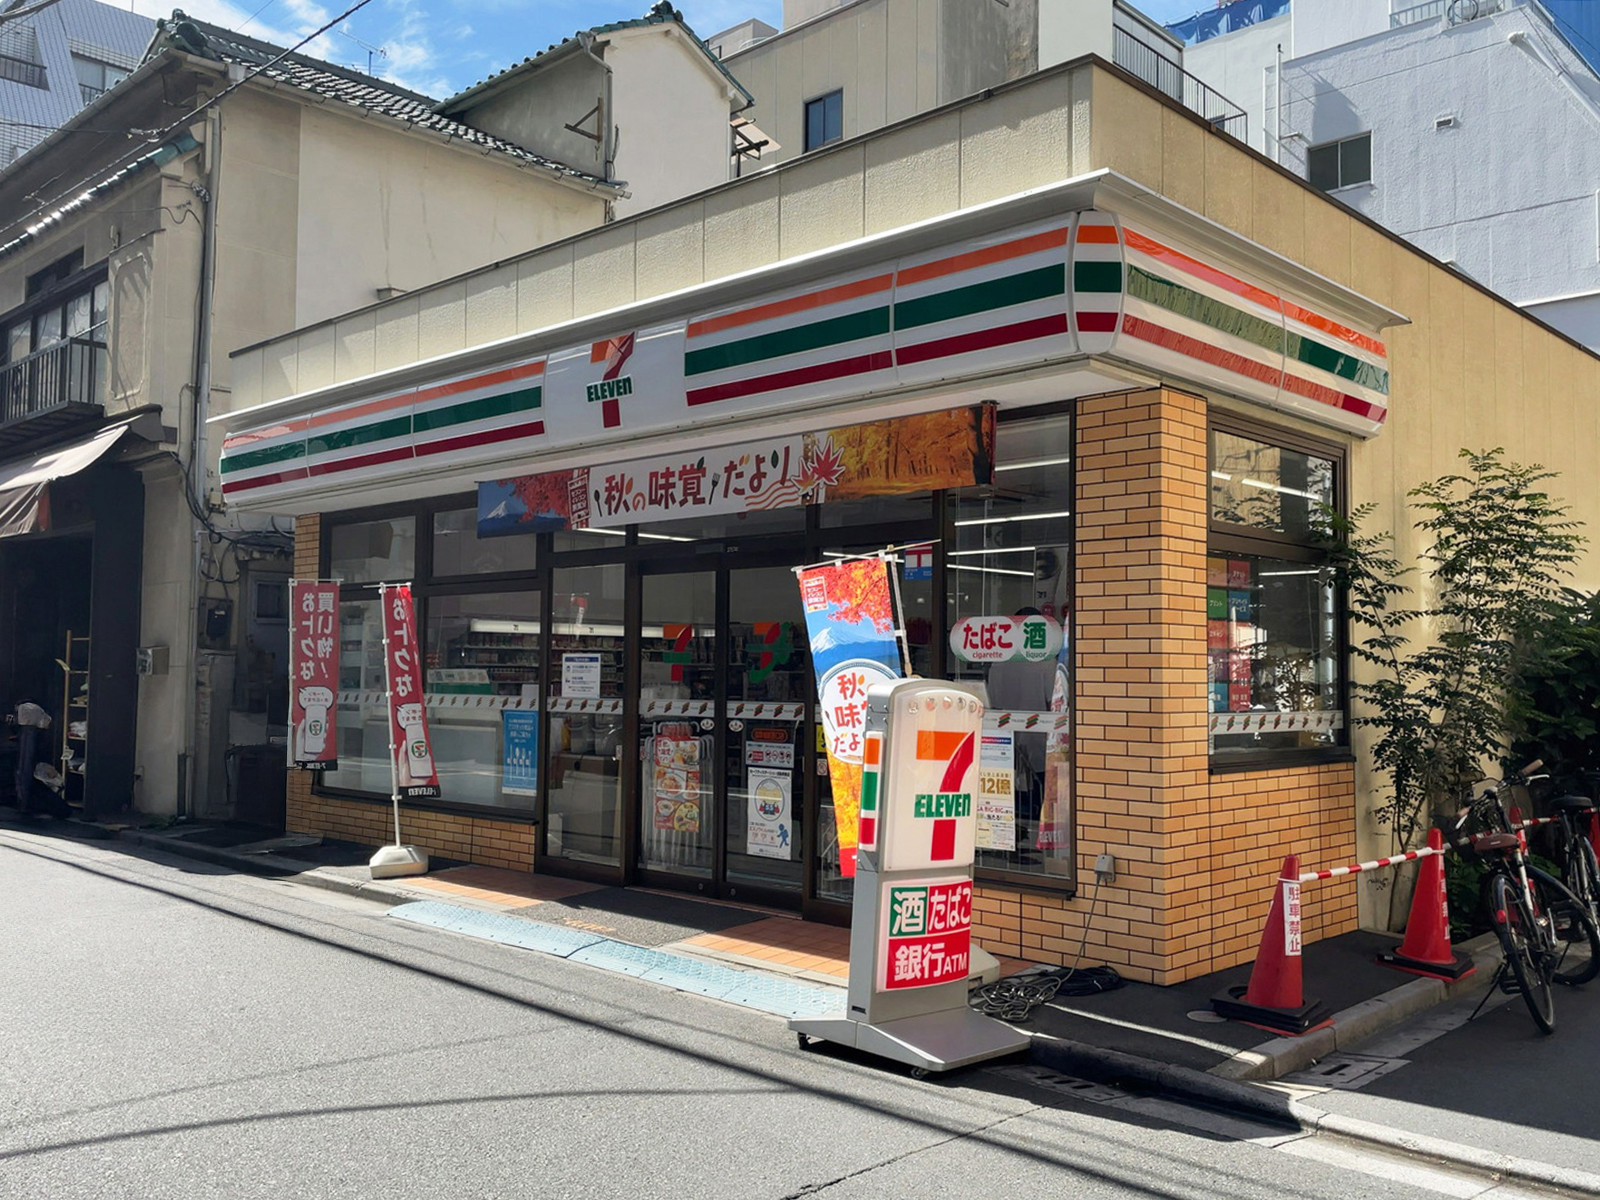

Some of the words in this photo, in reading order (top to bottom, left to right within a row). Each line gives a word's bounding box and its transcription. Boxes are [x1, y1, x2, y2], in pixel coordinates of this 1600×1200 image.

[963, 622, 1013, 650] たばこ
[1023, 622, 1047, 650] 酒
[972, 650, 1003, 659] cigarette
[1026, 650, 1047, 659] liquor
[916, 730, 975, 861] 7
[892, 890, 927, 935] 酒
[929, 885, 971, 931] たばこ
[1288, 886, 1301, 953] 駐車禁止
[894, 942, 968, 982] 銀行ATM
